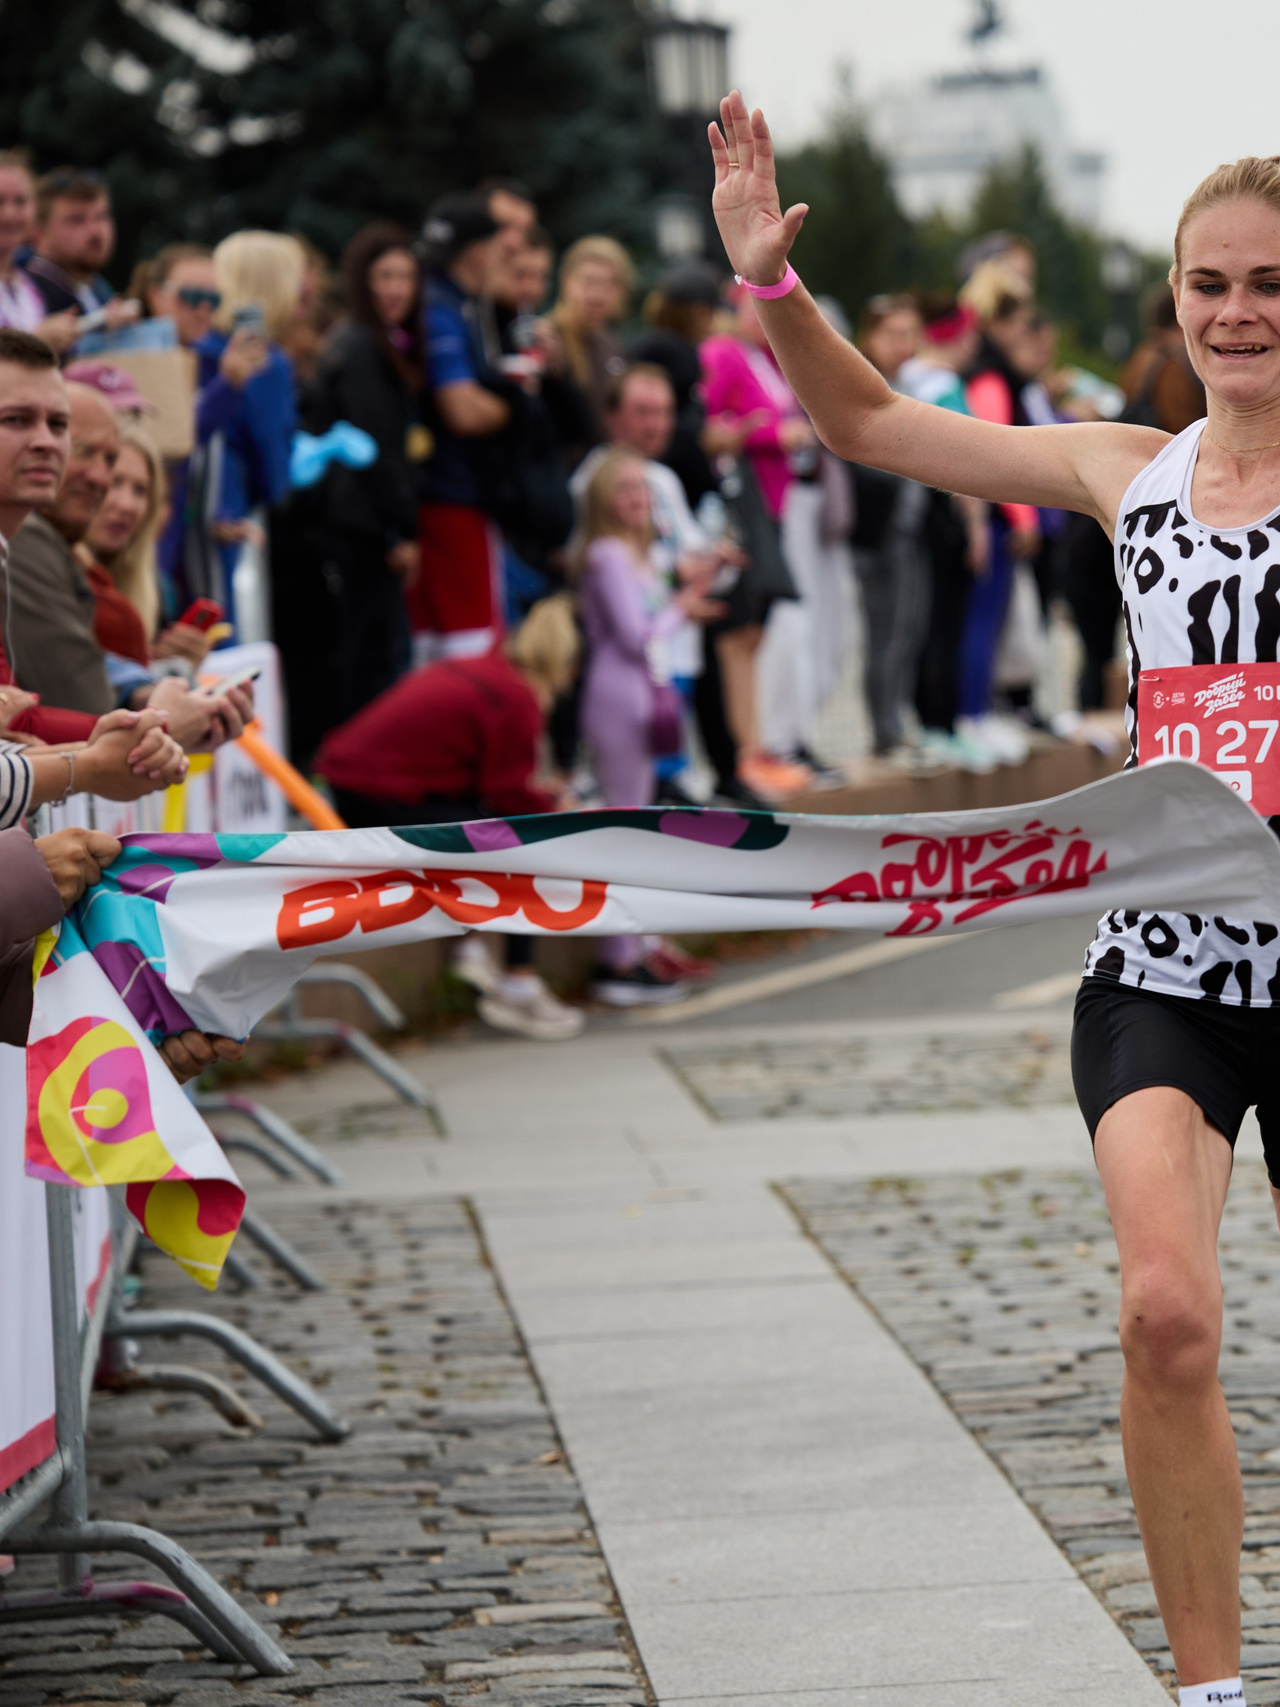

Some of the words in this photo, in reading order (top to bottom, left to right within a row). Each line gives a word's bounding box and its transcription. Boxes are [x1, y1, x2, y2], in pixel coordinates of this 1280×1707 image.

[1194, 671, 1247, 707] Добрый
[1203, 690, 1247, 719] забег
[1253, 685, 1274, 701] 10
[1154, 722, 1200, 764] 10
